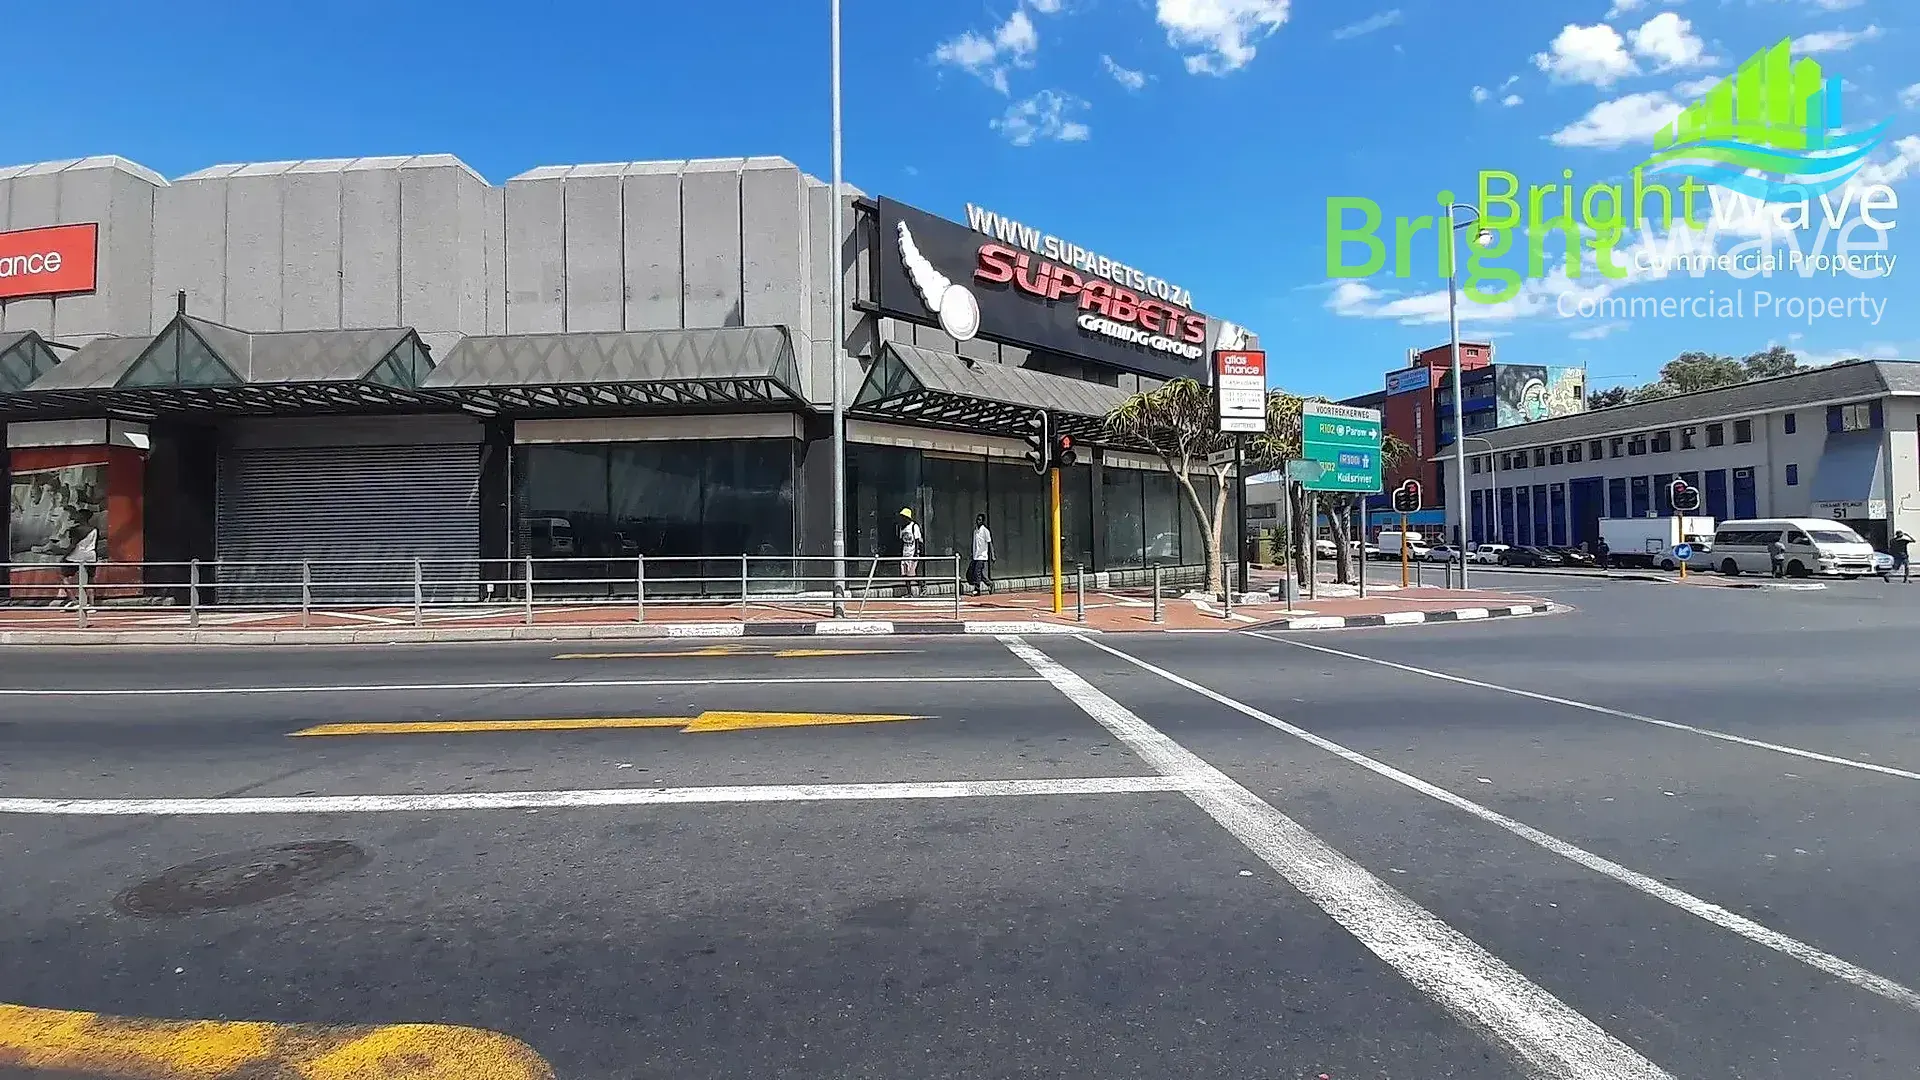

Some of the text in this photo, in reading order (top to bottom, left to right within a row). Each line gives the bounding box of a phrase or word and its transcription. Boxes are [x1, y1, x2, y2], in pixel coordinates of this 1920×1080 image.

[966, 202, 1193, 309] WWW.SUPABETS.CO.ZA
[973, 243, 1207, 344] SUPABETS
[1077, 313, 1204, 361] GAMING GROUP
[1224, 355, 1248, 365] atlas
[1225, 365, 1260, 375] finance
[1316, 405, 1370, 419] VOORTREKKERWEG
[1320, 423, 1367, 437] R102 Parow
[1833, 508, 1847, 518] 51
